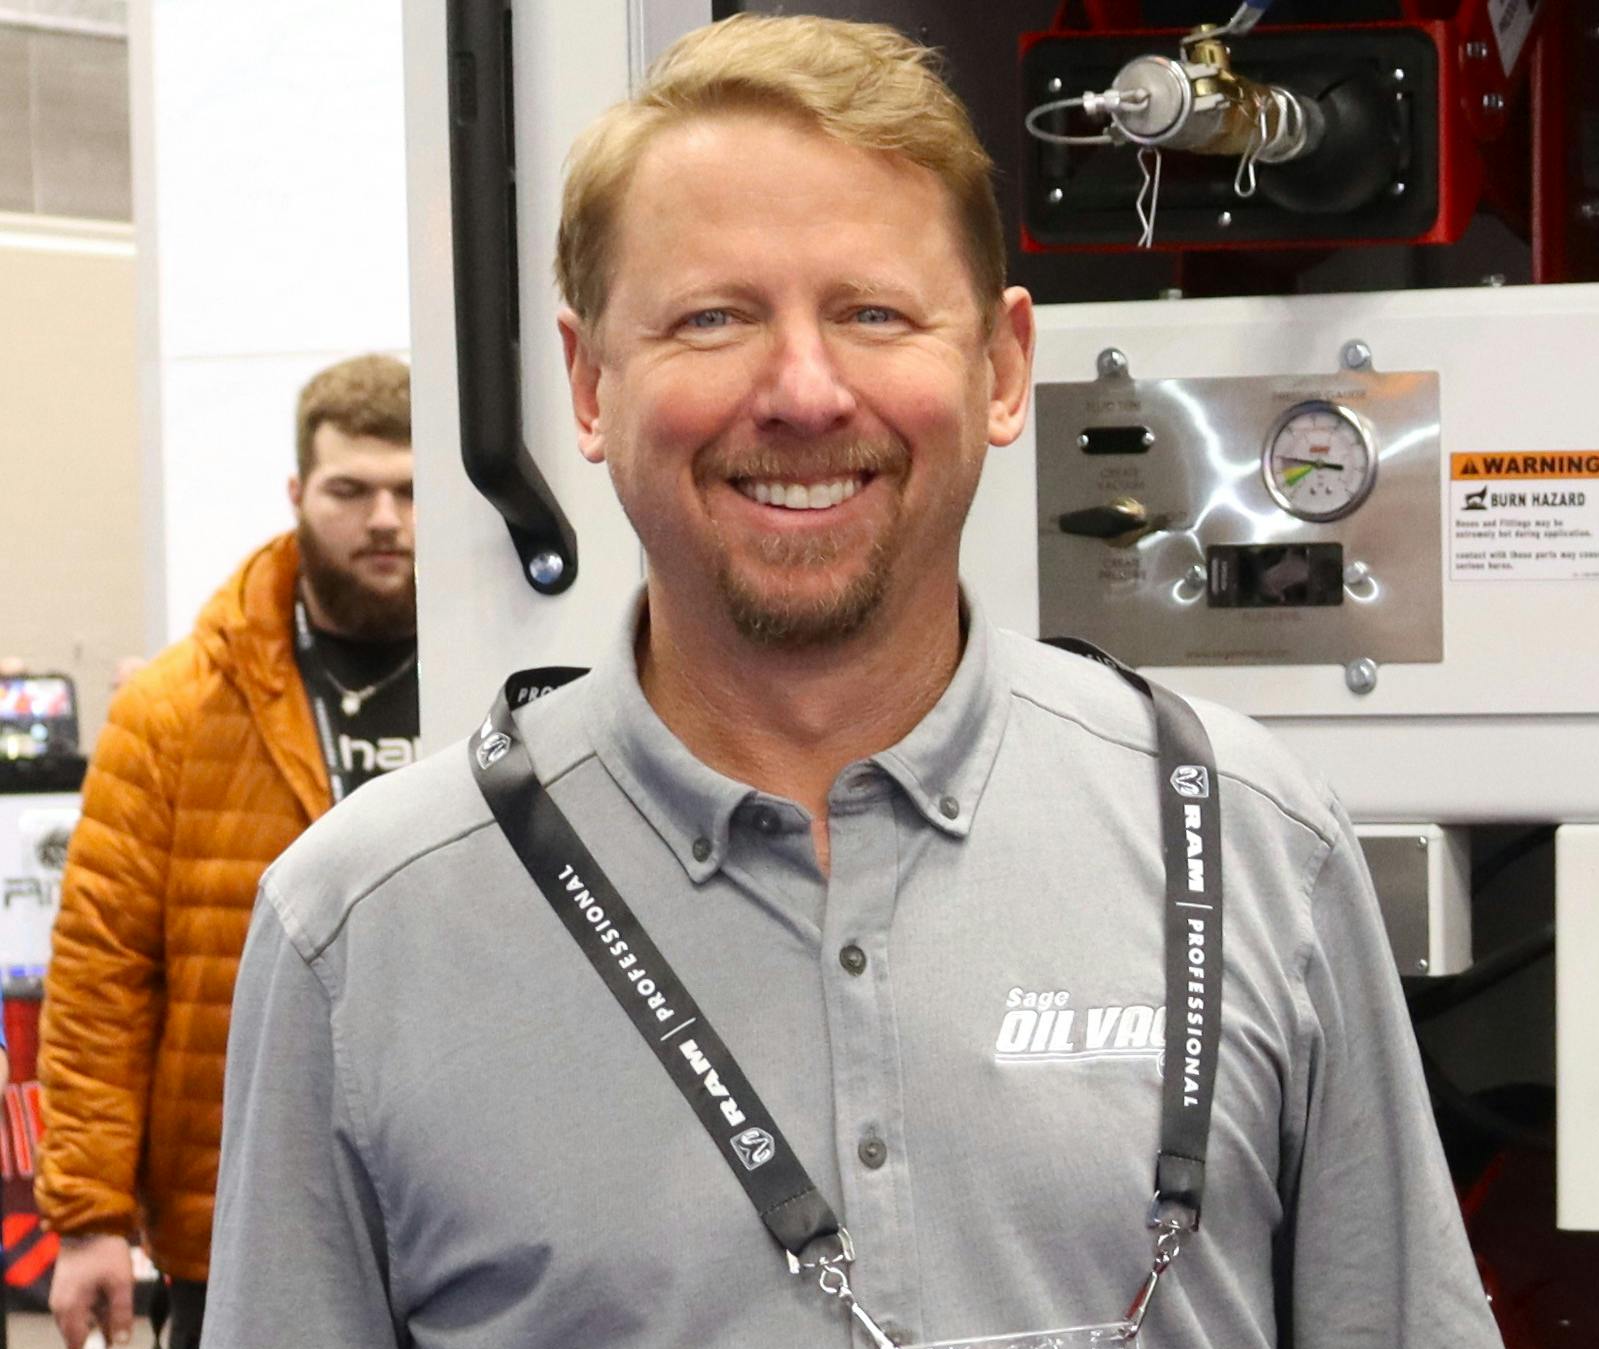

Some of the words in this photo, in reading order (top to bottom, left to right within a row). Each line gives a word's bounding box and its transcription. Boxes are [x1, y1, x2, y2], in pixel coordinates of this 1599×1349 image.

[1490, 493, 1526, 507] BURN
[1532, 492, 1585, 506] HAZARD
[1183, 804, 1204, 893] RAM
[558, 864, 675, 1022] PROFESSIONAL
[995, 1009, 1075, 1052] OIL
[1006, 987, 1071, 1011] Sage
[1184, 918, 1205, 1107] PROFESSIONAL
[679, 1039, 747, 1127] RAM
